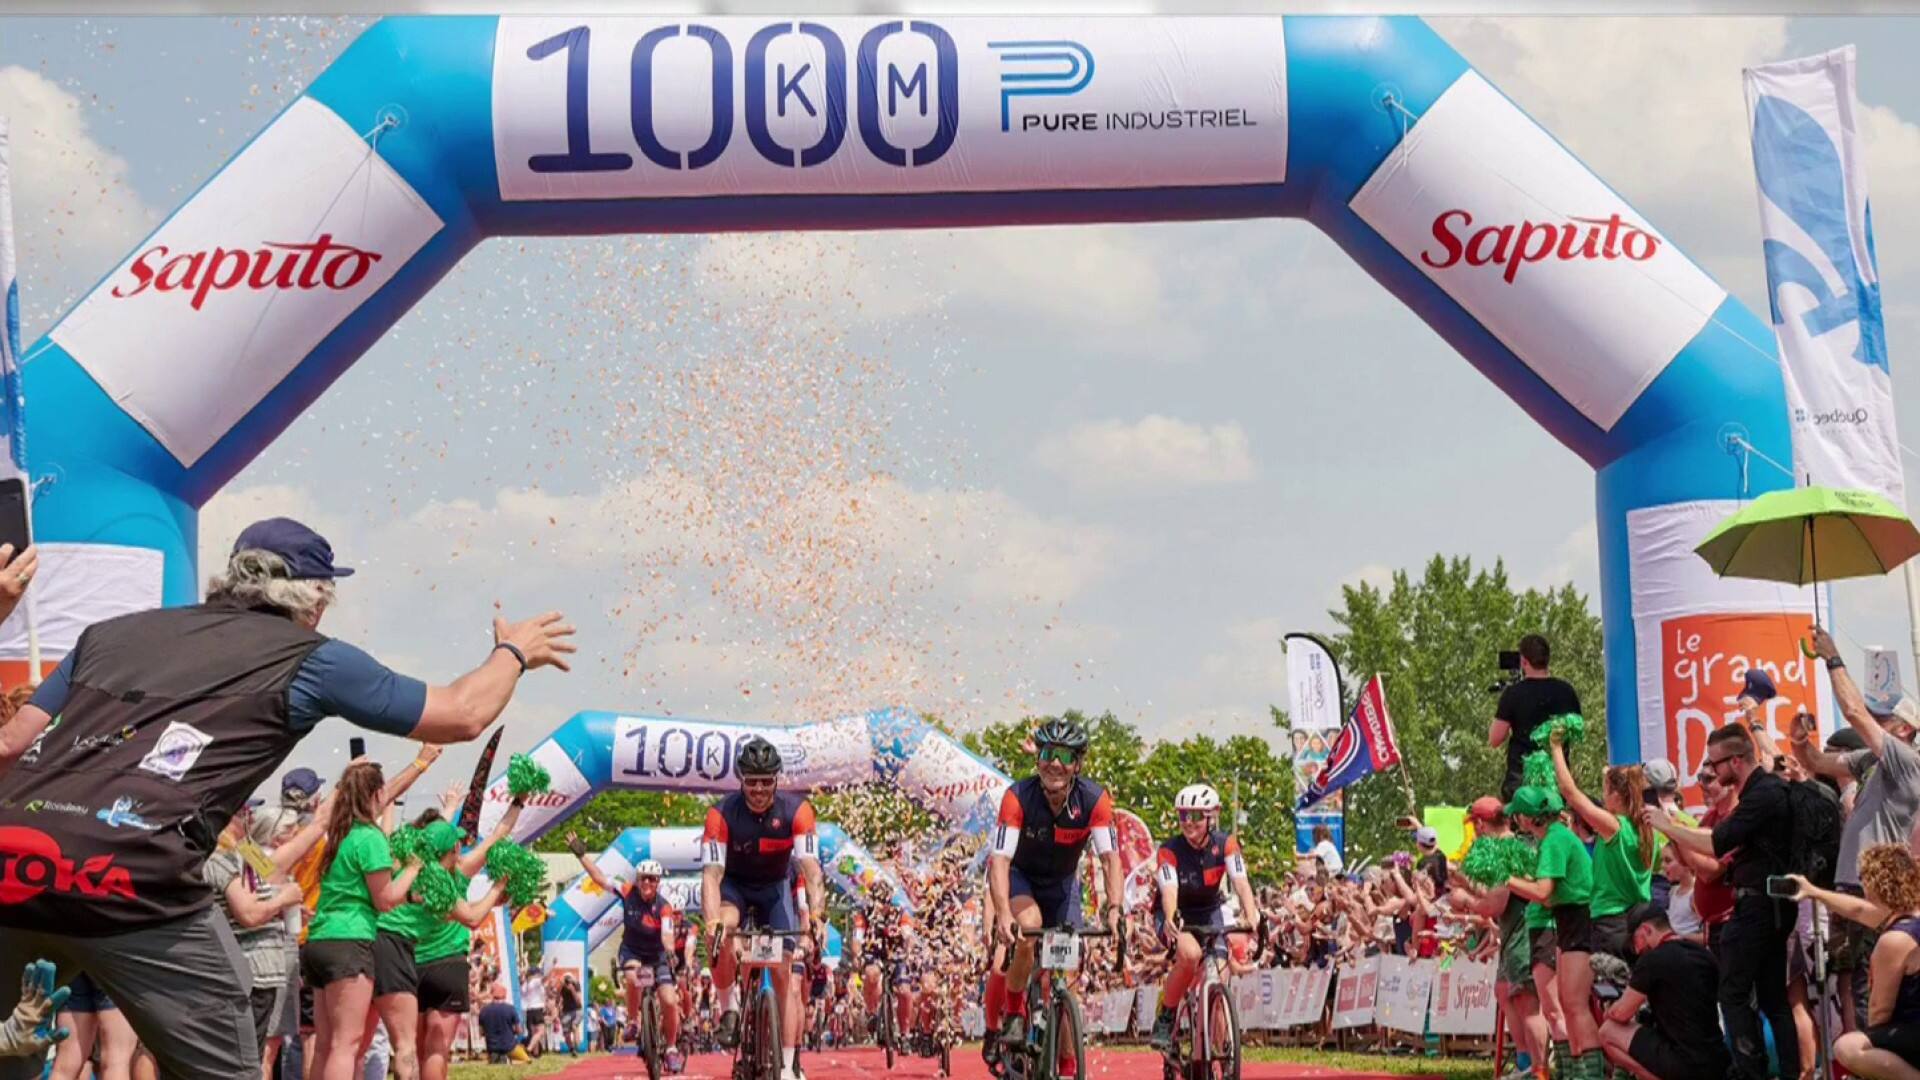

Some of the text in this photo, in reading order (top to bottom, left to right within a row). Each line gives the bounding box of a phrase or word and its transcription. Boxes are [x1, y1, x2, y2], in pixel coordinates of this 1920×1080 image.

[527, 21, 958, 172] 1000
[1022, 109, 1257, 132] PURE INDUSTRIEL
[112, 234, 381, 311] Saputo
[1421, 209, 1662, 284] Saputo
[1674, 639, 1807, 705] grand
[1677, 629, 1701, 654] le
